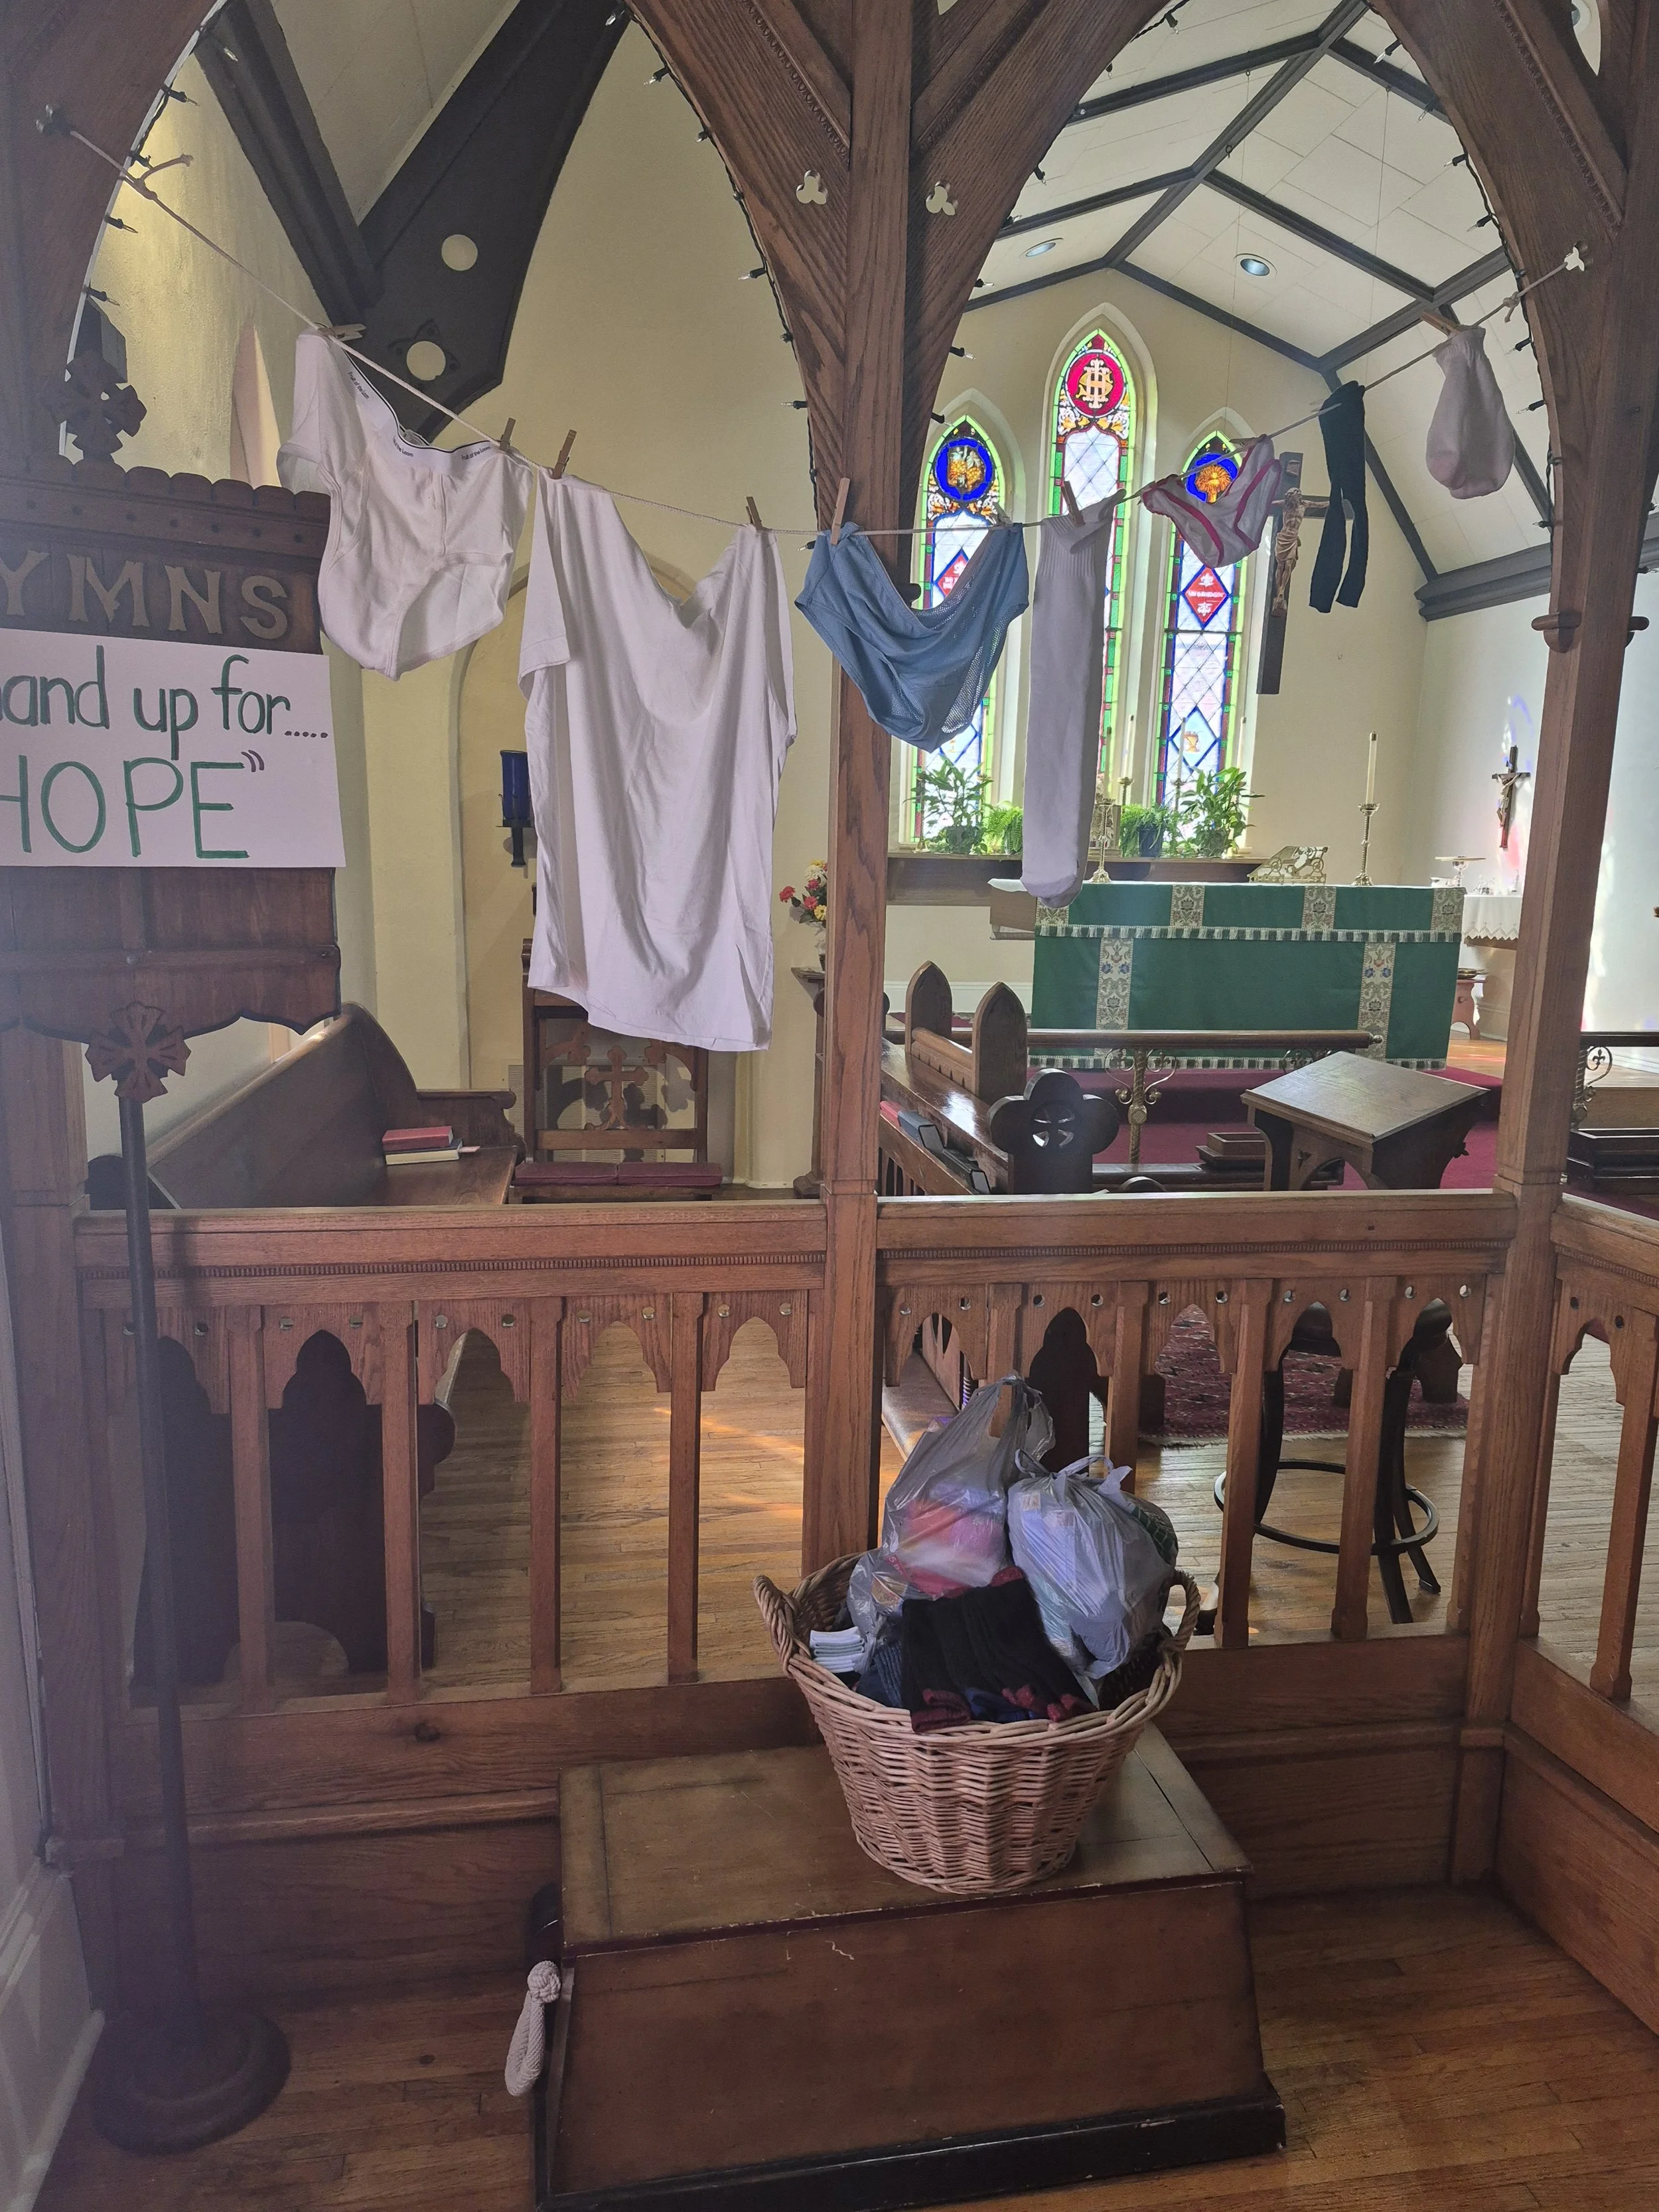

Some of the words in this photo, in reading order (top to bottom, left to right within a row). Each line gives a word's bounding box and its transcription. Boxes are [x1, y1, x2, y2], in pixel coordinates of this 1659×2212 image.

[401, 448, 413, 457] Loom
[0, 644, 109, 729] and
[133, 687, 199, 761] up
